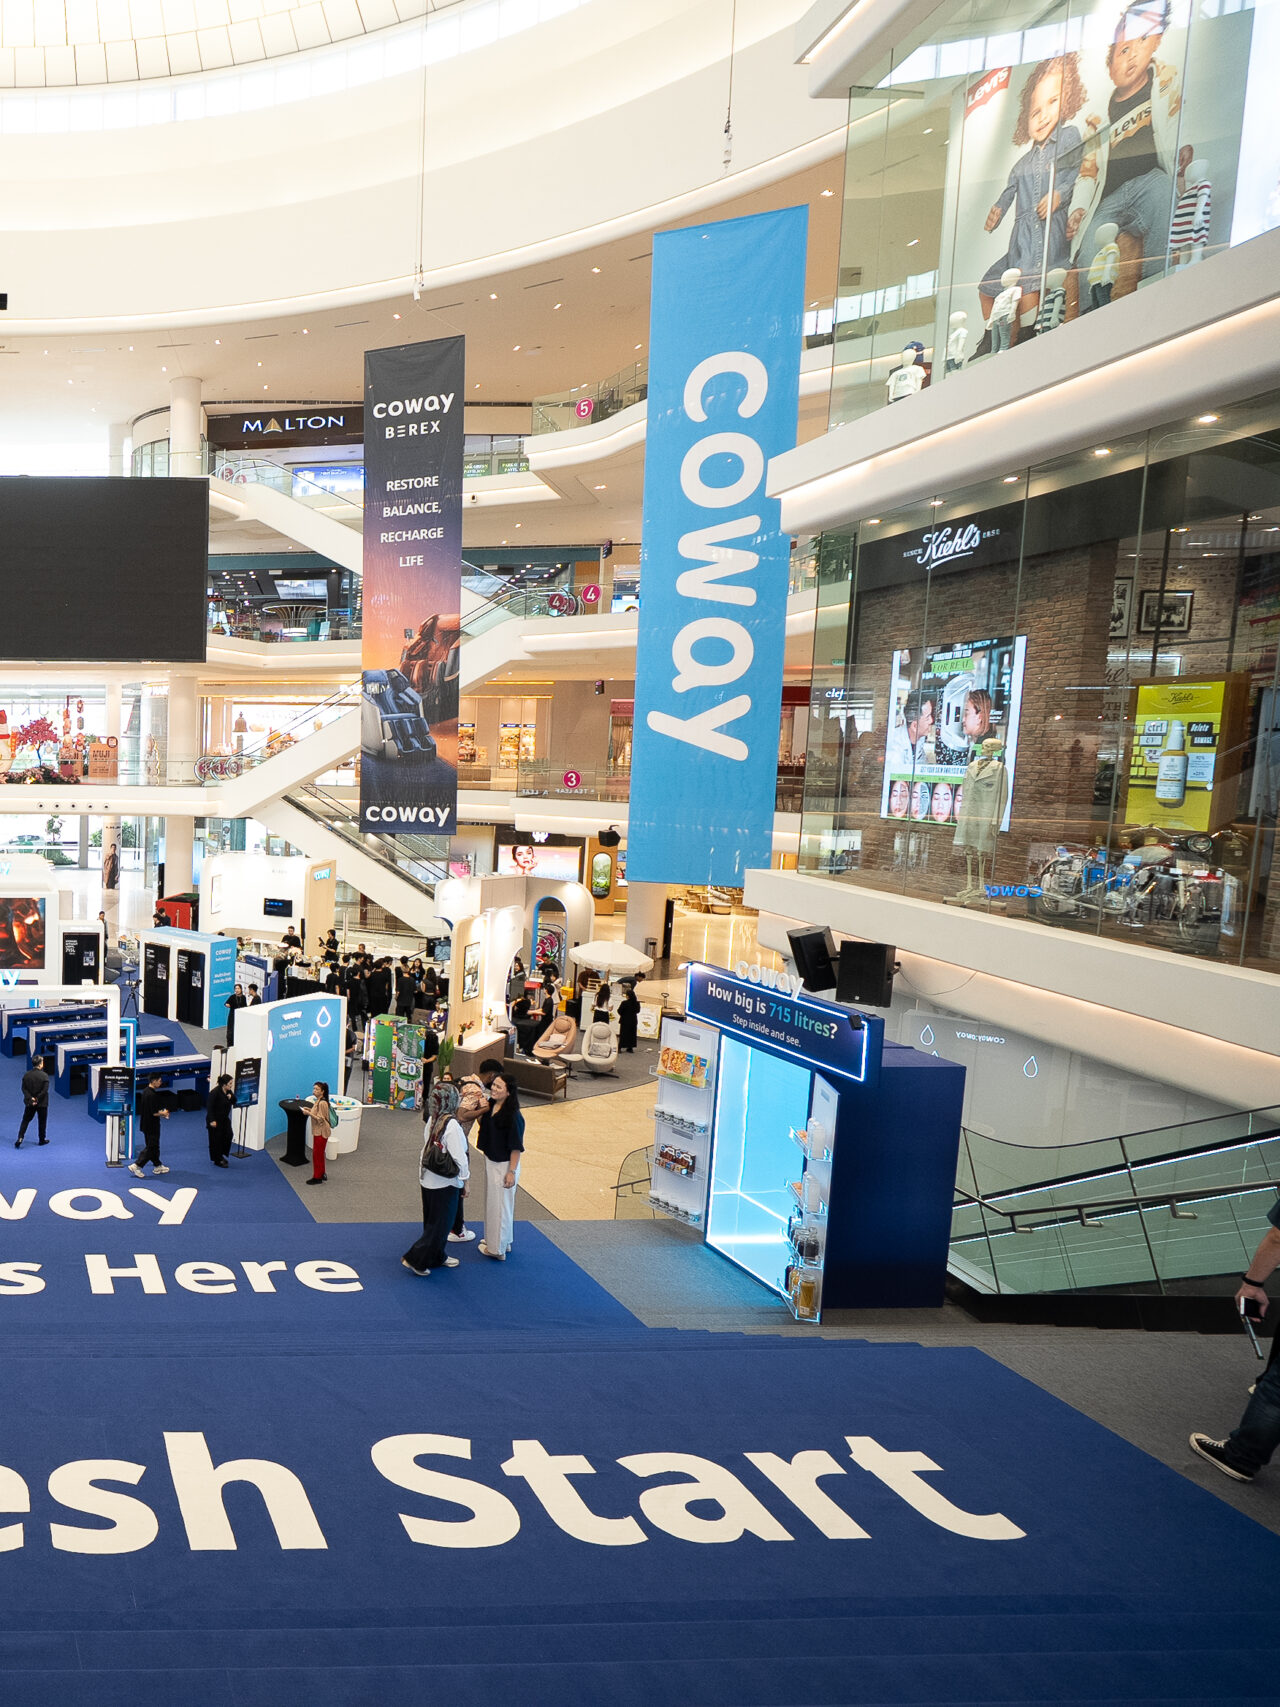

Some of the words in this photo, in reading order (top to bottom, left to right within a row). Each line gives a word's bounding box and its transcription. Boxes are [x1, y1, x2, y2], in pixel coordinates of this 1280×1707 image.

[372, 392, 455, 420] coway
[581, 400, 589, 417] 5
[242, 416, 345, 435] MALTON
[385, 475, 439, 492] RESTORE
[382, 502, 442, 518] BALANCE,
[380, 527, 444, 544] RECHARGE
[917, 523, 981, 566] Kiehl's
[399, 554, 424, 568] LIFE
[647, 351, 768, 762] coway
[552, 596, 560, 607] 4
[586, 587, 596, 601] 4
[825, 688, 846, 701] clef
[1147, 723, 1164, 733] ctrl
[567, 773, 577, 787] 3
[366, 805, 451, 827] coway
[215, 948, 233, 956] coway
[735, 960, 805, 1001] coway
[707, 981, 733, 1003] How
[735, 989, 753, 1014] big
[756, 997, 767, 1015] is
[769, 1002, 791, 1023] 715
[794, 1009, 838, 1040] litres?
[732, 1013, 748, 1029] Step
[748, 1019, 770, 1036] inside
[770, 1028, 785, 1041] and
[786, 1034, 801, 1048] see.
[400, 1061, 417, 1075] 20
[85, 1253, 365, 1295] Here
[370, 1433, 1028, 1549] Start
